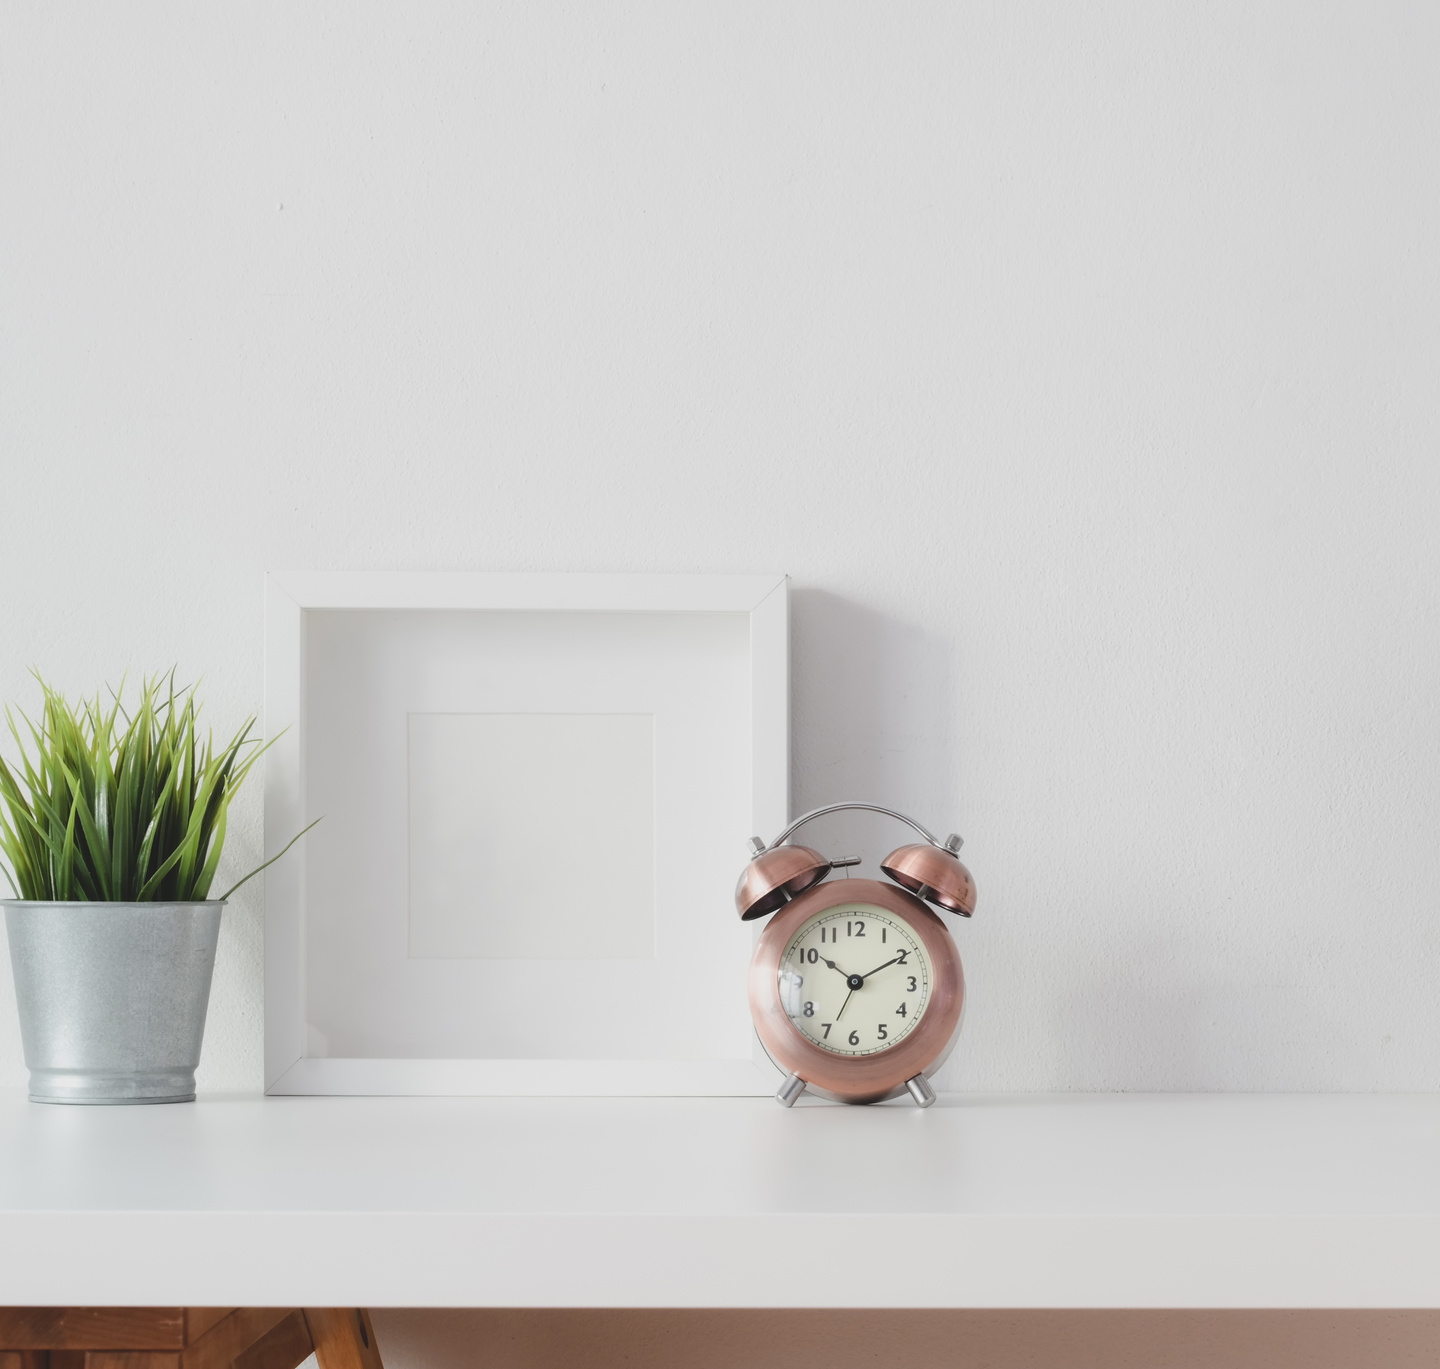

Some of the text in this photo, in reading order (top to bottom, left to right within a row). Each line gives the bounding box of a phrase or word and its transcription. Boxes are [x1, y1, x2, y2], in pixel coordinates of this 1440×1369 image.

[821, 927, 837, 943] 11
[847, 921, 866, 937] 12
[882, 927, 887, 944] 1
[800, 948, 819, 964] 10
[896, 949, 908, 965] 2
[906, 976, 917, 992] 3
[803, 1001, 815, 1018] 8
[895, 1002, 908, 1018] 4
[821, 1023, 832, 1040] 7
[848, 1030, 860, 1046] 6
[877, 1024, 888, 1040] 5
